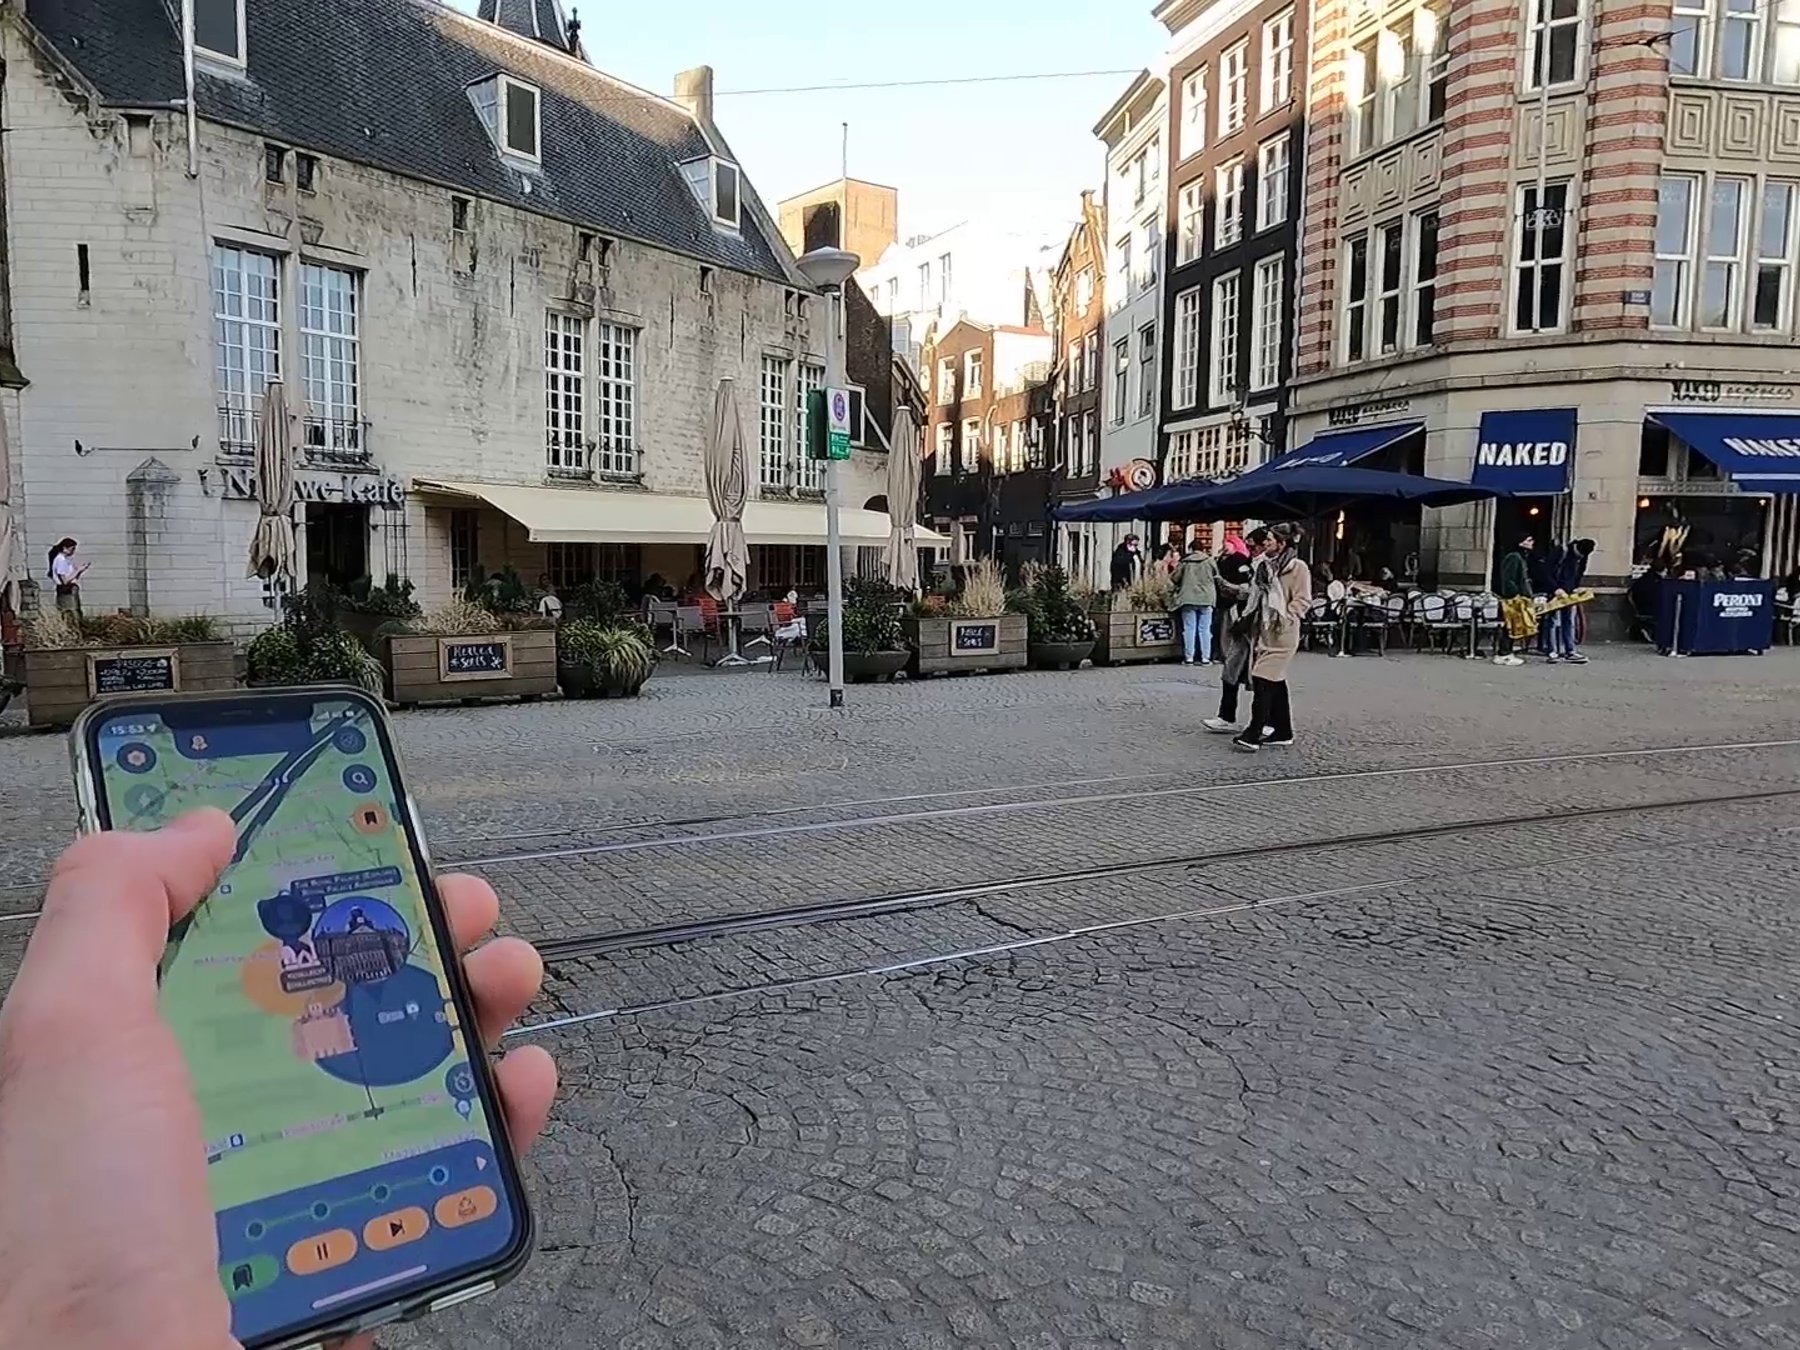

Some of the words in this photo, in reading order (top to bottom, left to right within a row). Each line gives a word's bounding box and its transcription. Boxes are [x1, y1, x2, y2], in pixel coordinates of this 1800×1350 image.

[1479, 442, 1567, 466] NAKED
[1722, 438, 1800, 457] NAKE
[1713, 593, 1763, 607] PERONI
